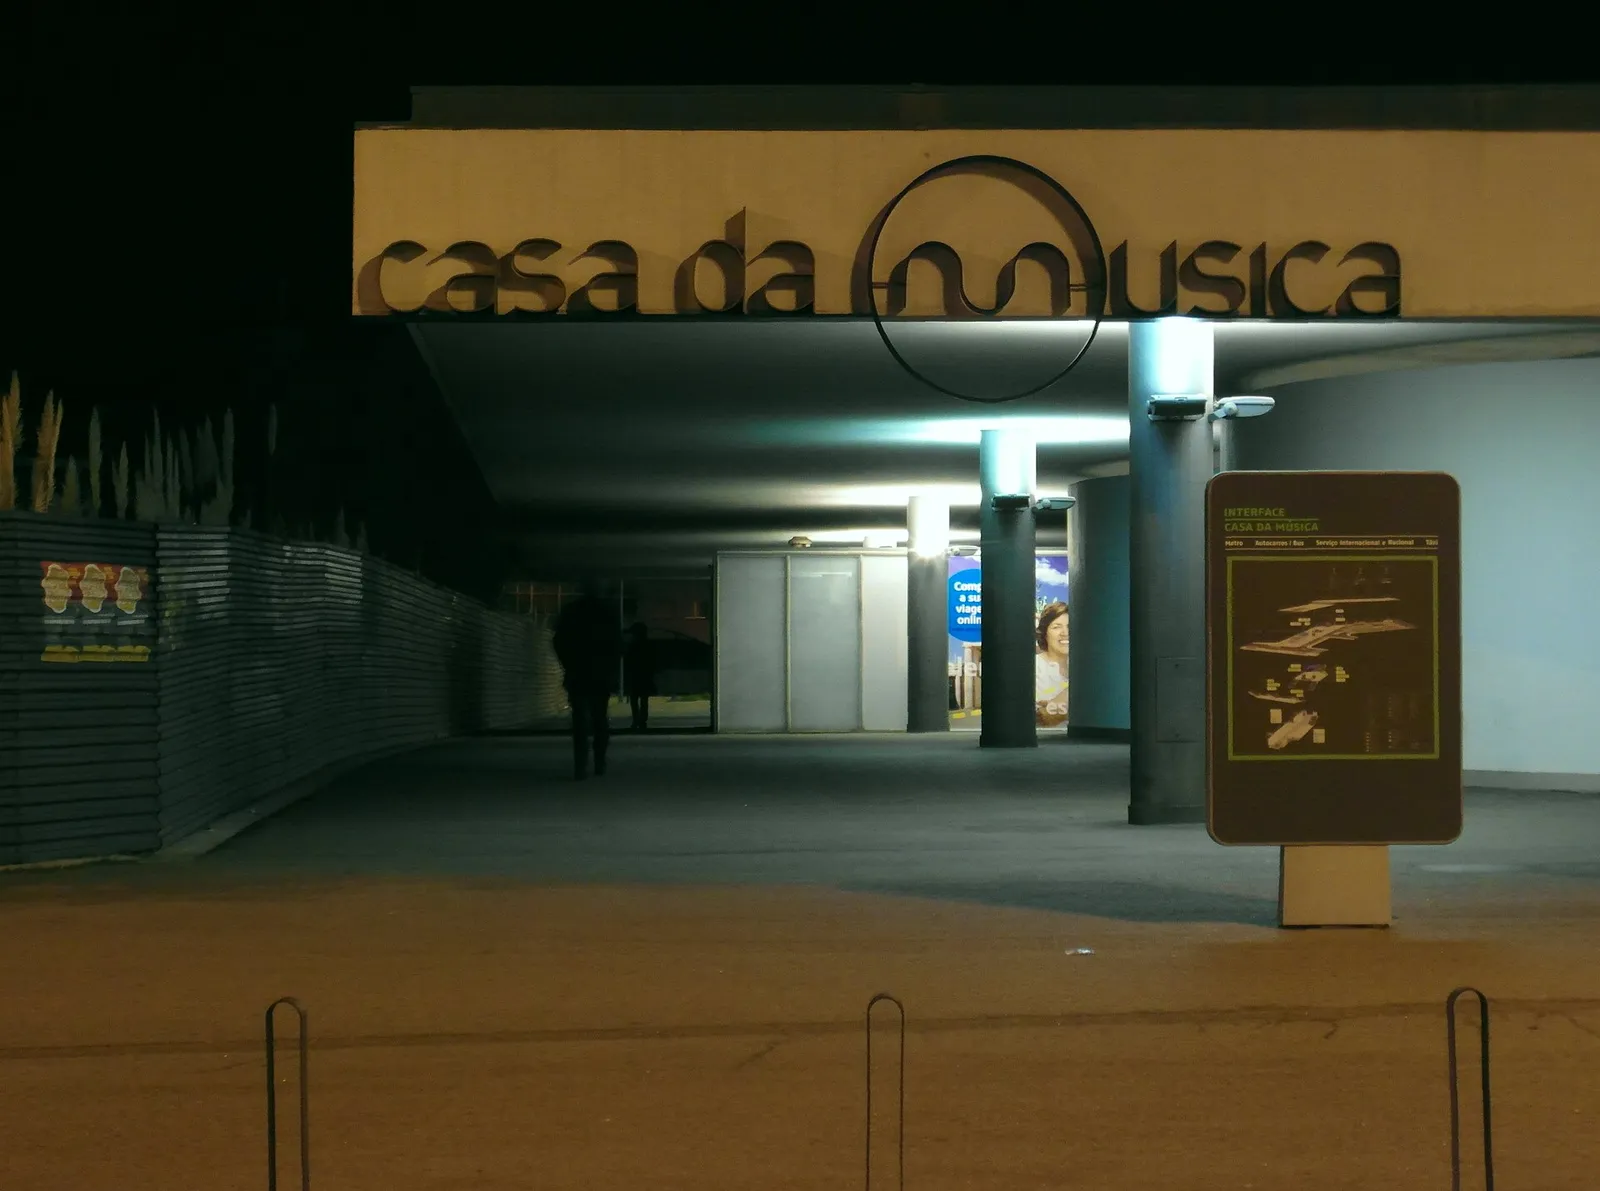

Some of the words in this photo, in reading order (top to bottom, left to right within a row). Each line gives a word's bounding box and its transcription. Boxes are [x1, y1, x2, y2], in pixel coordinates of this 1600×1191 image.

[358, 238, 638, 313] casa
[675, 206, 816, 313] da
[1224, 507, 1285, 517] INTERFACE
[1224, 522, 1254, 532] CASA
[1256, 522, 1273, 532] DA
[959, 594, 967, 602] a
[967, 594, 982, 602] su
